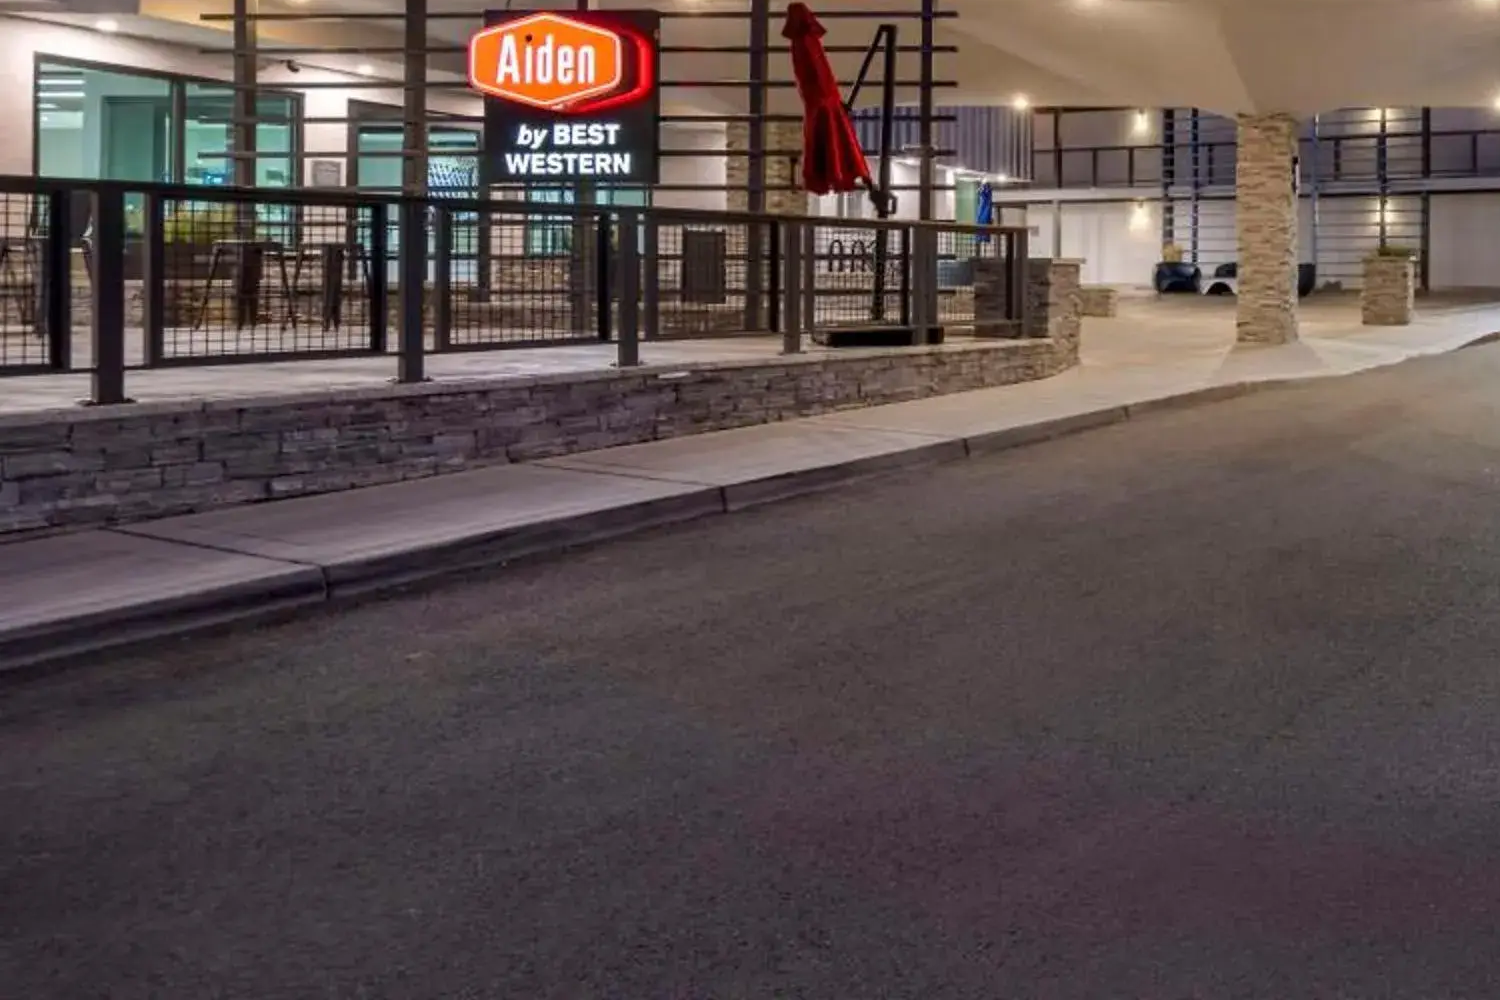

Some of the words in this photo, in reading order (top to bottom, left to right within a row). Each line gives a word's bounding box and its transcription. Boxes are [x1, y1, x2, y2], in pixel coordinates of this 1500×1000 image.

[495, 33, 596, 85] Aiden
[516, 123, 548, 149] by
[552, 124, 621, 146] BEST
[504, 153, 631, 175] WESTERN
